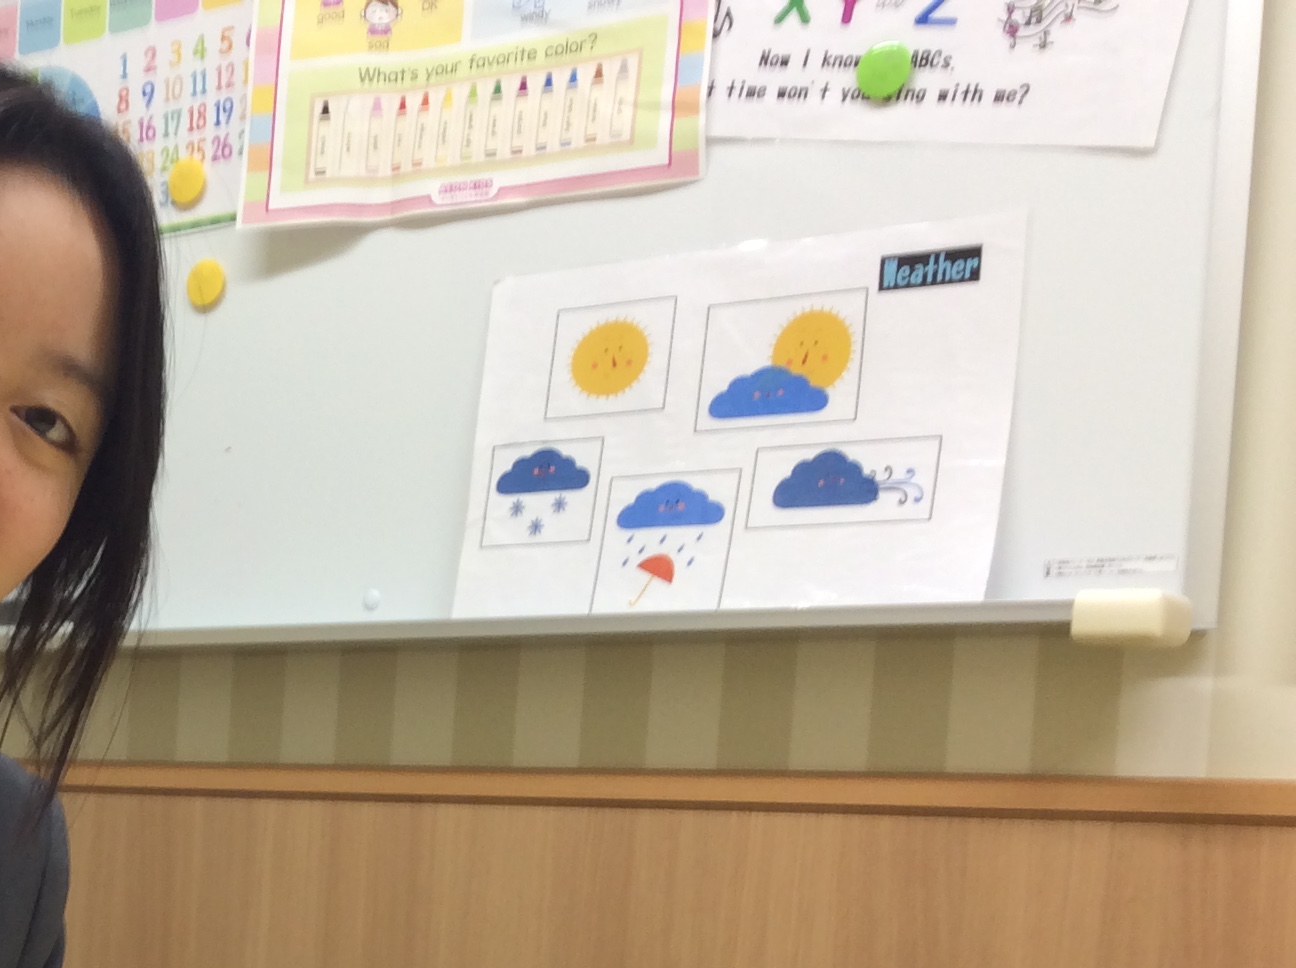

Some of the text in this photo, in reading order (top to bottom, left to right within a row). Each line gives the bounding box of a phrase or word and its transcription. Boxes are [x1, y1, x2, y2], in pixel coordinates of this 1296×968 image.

[120, 52, 128, 79] 1
[144, 44, 157, 74] 2
[169, 39, 182, 68] 3
[192, 33, 207, 61] 4
[218, 25, 234, 55] 5
[358, 32, 598, 84] What's your favorite color?
[758, 48, 791, 68] Now
[802, 48, 811, 69] I
[116, 85, 130, 114] 8
[141, 79, 155, 109] 9
[164, 74, 184, 103] 10
[190, 67, 207, 97] 11
[215, 61, 235, 91] 12
[726, 79, 767, 99] time
[936, 82, 984, 103] with
[992, 82, 1031, 105] me?
[138, 114, 156, 143] 16
[163, 108, 182, 138] 17
[187, 101, 207, 132] 18
[214, 96, 234, 127] 19
[211, 131, 233, 162] 26
[881, 250, 980, 288] Weather
